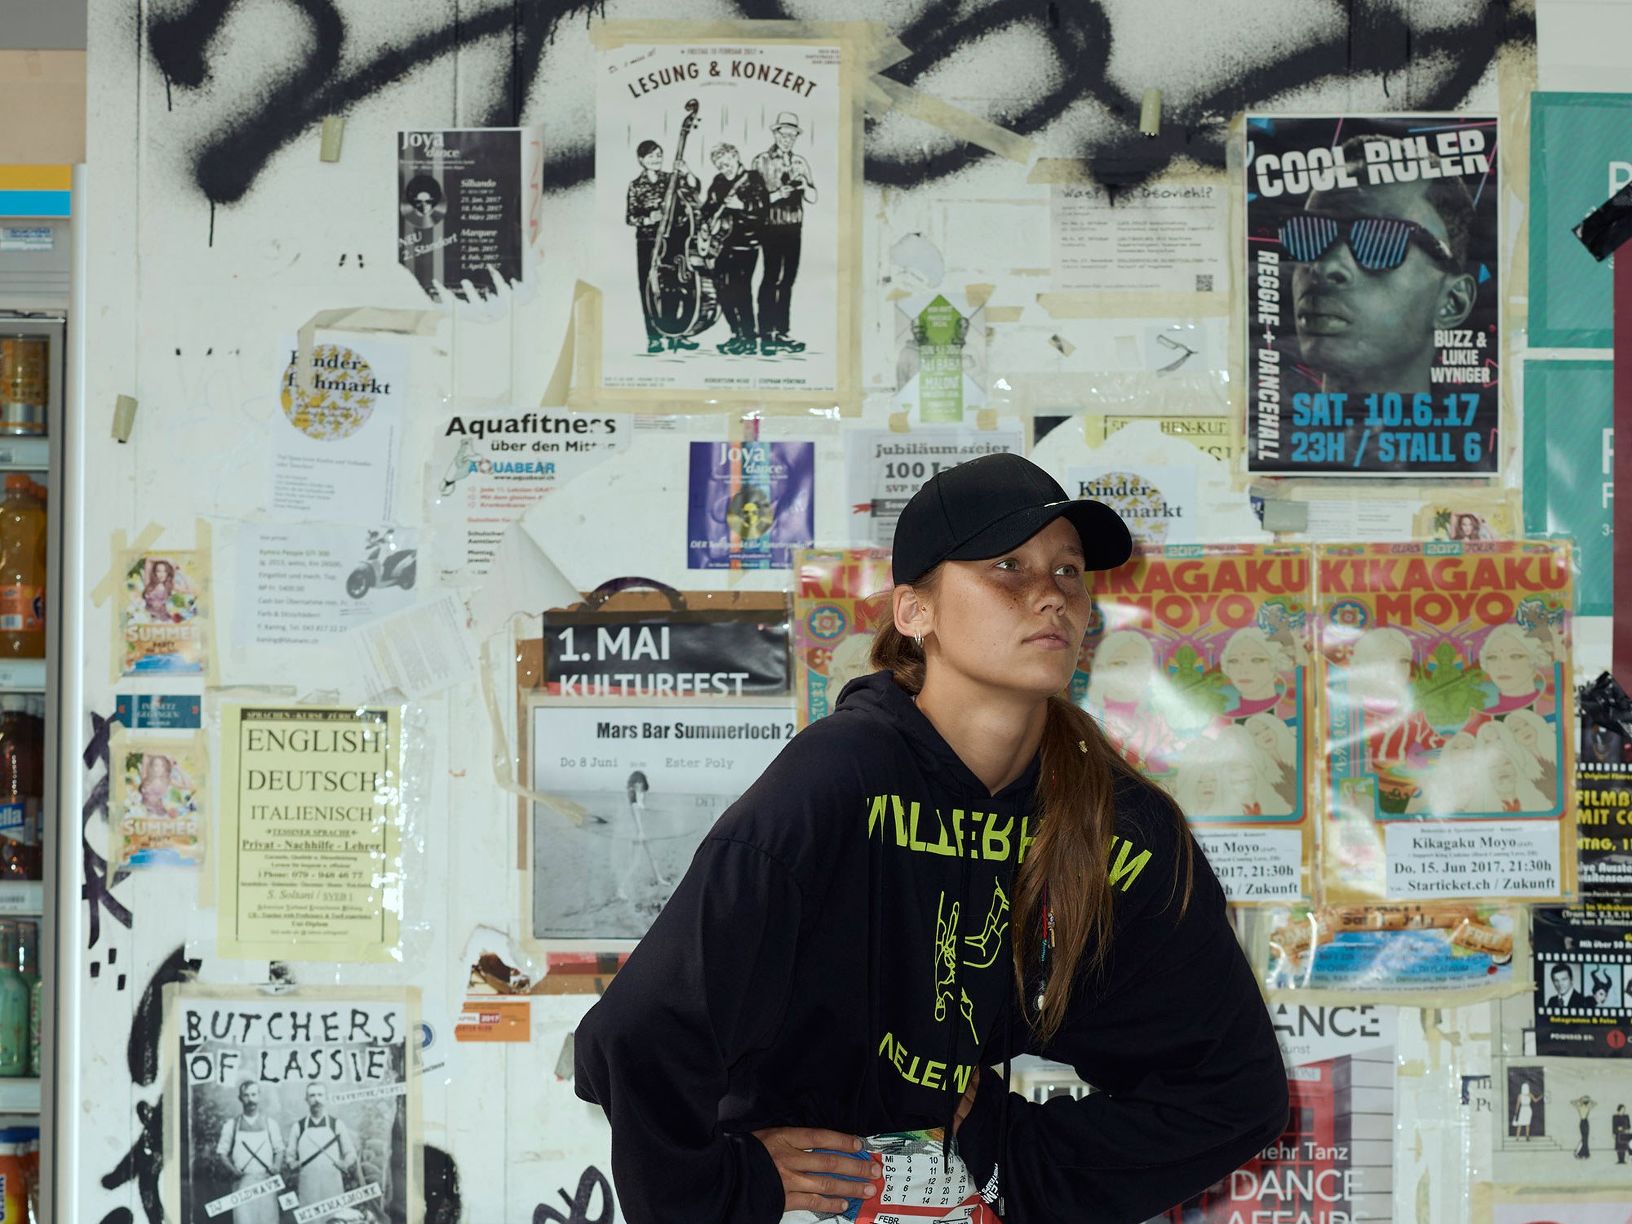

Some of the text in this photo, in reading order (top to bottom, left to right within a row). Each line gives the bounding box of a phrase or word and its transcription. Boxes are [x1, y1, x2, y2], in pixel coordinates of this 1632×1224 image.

[628, 60, 817, 98] LESUNG & KONZERT
[1255, 129, 1490, 198] COOL RULER
[1434, 329, 1487, 348] BUZZ &
[1258, 250, 1280, 461] REGGAE + DANCEHALL
[1442, 349, 1479, 366] LUKIE
[288, 373, 391, 395] fhmarkt
[1431, 366, 1490, 384] WYNIGER
[1292, 392, 1480, 427] SAT. 10.6.17
[491, 440, 559, 452] über den
[719, 443, 765, 466] Joya
[1291, 429, 1481, 468] 23H / STALL 6
[746, 463, 784, 475] dance
[885, 463, 925, 479] 100
[1078, 480, 1160, 497] Kinder-
[1094, 559, 1310, 594] IKAGAKU
[1320, 557, 1569, 593] KIKAGAKU
[1375, 592, 1515, 627] MOYO
[558, 626, 670, 662] 1. MAI
[597, 722, 781, 740] Mars Bar Summerloch
[246, 728, 381, 754] ENGLISH
[560, 757, 576, 768] Do
[591, 757, 618, 768] Juni
[665, 757, 701, 768] Ester
[705, 757, 734, 769] Poly
[246, 769, 378, 793] DEUTSCH
[1575, 790, 1632, 807] FILMB
[250, 805, 373, 822] ITALIENISCH
[242, 839, 381, 851] Privat Nachhilfe Lehrer
[1224, 842, 1260, 854] Moyo
[1412, 836, 1517, 851] Kikagaku Moyo
[1252, 866, 1294, 877] 21:30h
[1394, 860, 1552, 875] Do. 15. Jun 2017, 21:30h
[1246, 883, 1299, 895] Zukunft
[1408, 877, 1555, 892] Starticket.ch Zukunft
[1274, 1006, 1380, 1037] ANCE
[190, 1049, 386, 1083] OF LASSIE
[1303, 1141, 1349, 1161] Tanz
[1230, 1170, 1364, 1202] DANCE
